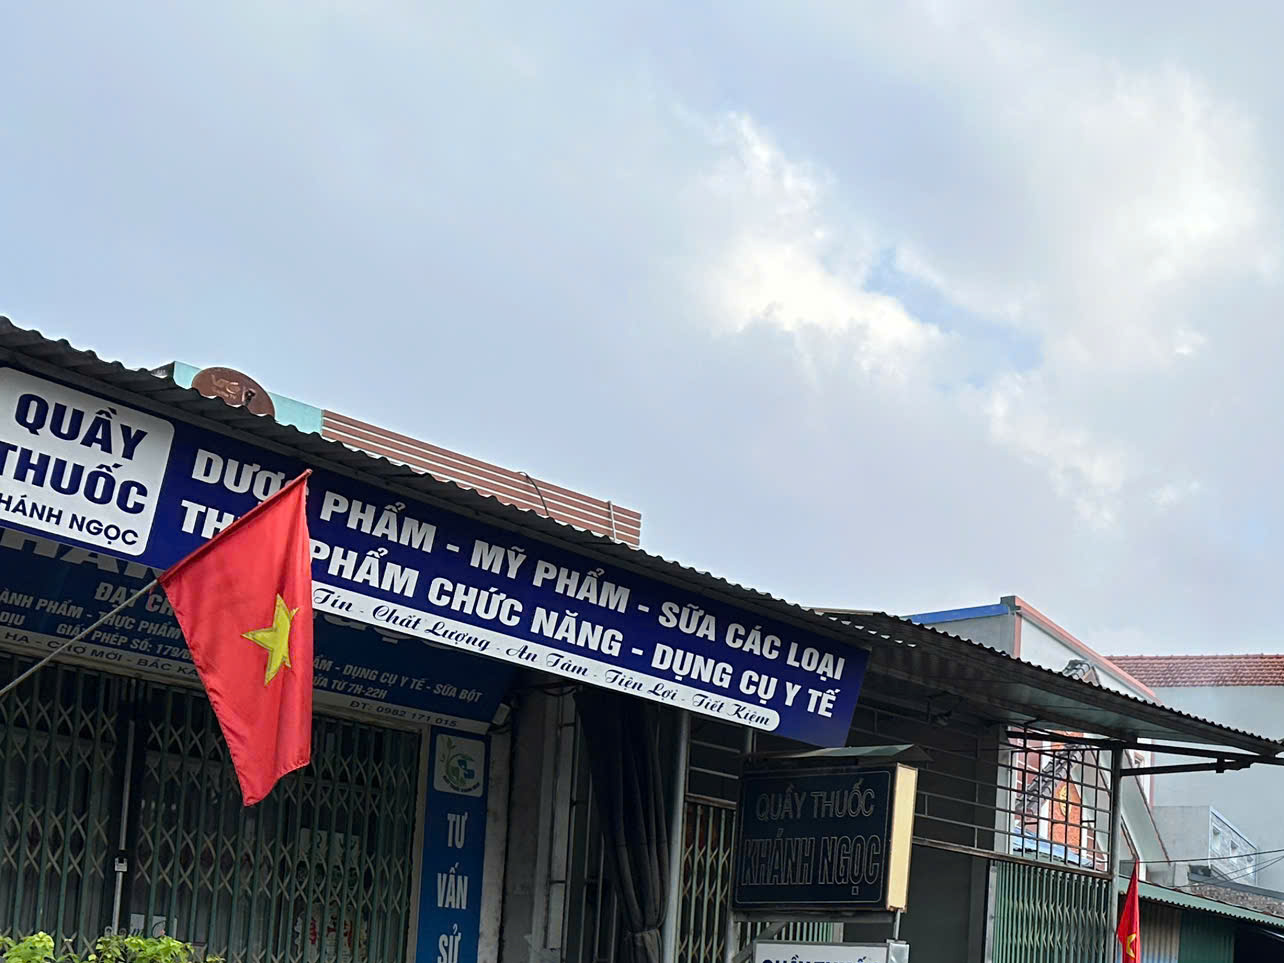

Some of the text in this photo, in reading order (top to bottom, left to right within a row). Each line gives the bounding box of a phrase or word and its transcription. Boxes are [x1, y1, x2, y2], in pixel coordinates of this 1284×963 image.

[15, 393, 147, 461] QUẦY
[0, 441, 148, 515] THUỐC
[69, 514, 138, 546] NGỌC
[192, 449, 309, 504] DƯỢ
[320, 491, 437, 554] PHẨM
[470, 539, 529, 580] MỸ
[533, 560, 630, 614] PHẨM
[658, 602, 717, 643] SỮA
[725, 623, 782, 661] CÁC
[786, 642, 846, 682] LOẠI
[311, 546, 420, 600] PHẨM
[427, 576, 523, 628] CHỨC
[531, 609, 625, 657] NĂNG
[651, 643, 734, 690] DỤNG
[740, 669, 780, 706] CỤ
[784, 682, 806, 708] Y
[807, 687, 840, 719] TẾ
[313, 588, 353, 612] Tín
[372, 605, 422, 631] Chất
[425, 621, 491, 651] Lượng
[505, 642, 539, 664] An
[545, 652, 590, 679] Tâm
[604, 669, 648, 695] Tiện
[646, 678, 680, 705] Lợi
[691, 692, 726, 715] Tiết
[728, 701, 771, 728] Kiệm
[447, 813, 469, 849] TƯ
[811, 778, 875, 819] THUỐC
[437, 861, 469, 909] VẤN
[818, 834, 881, 896] NGỌC
